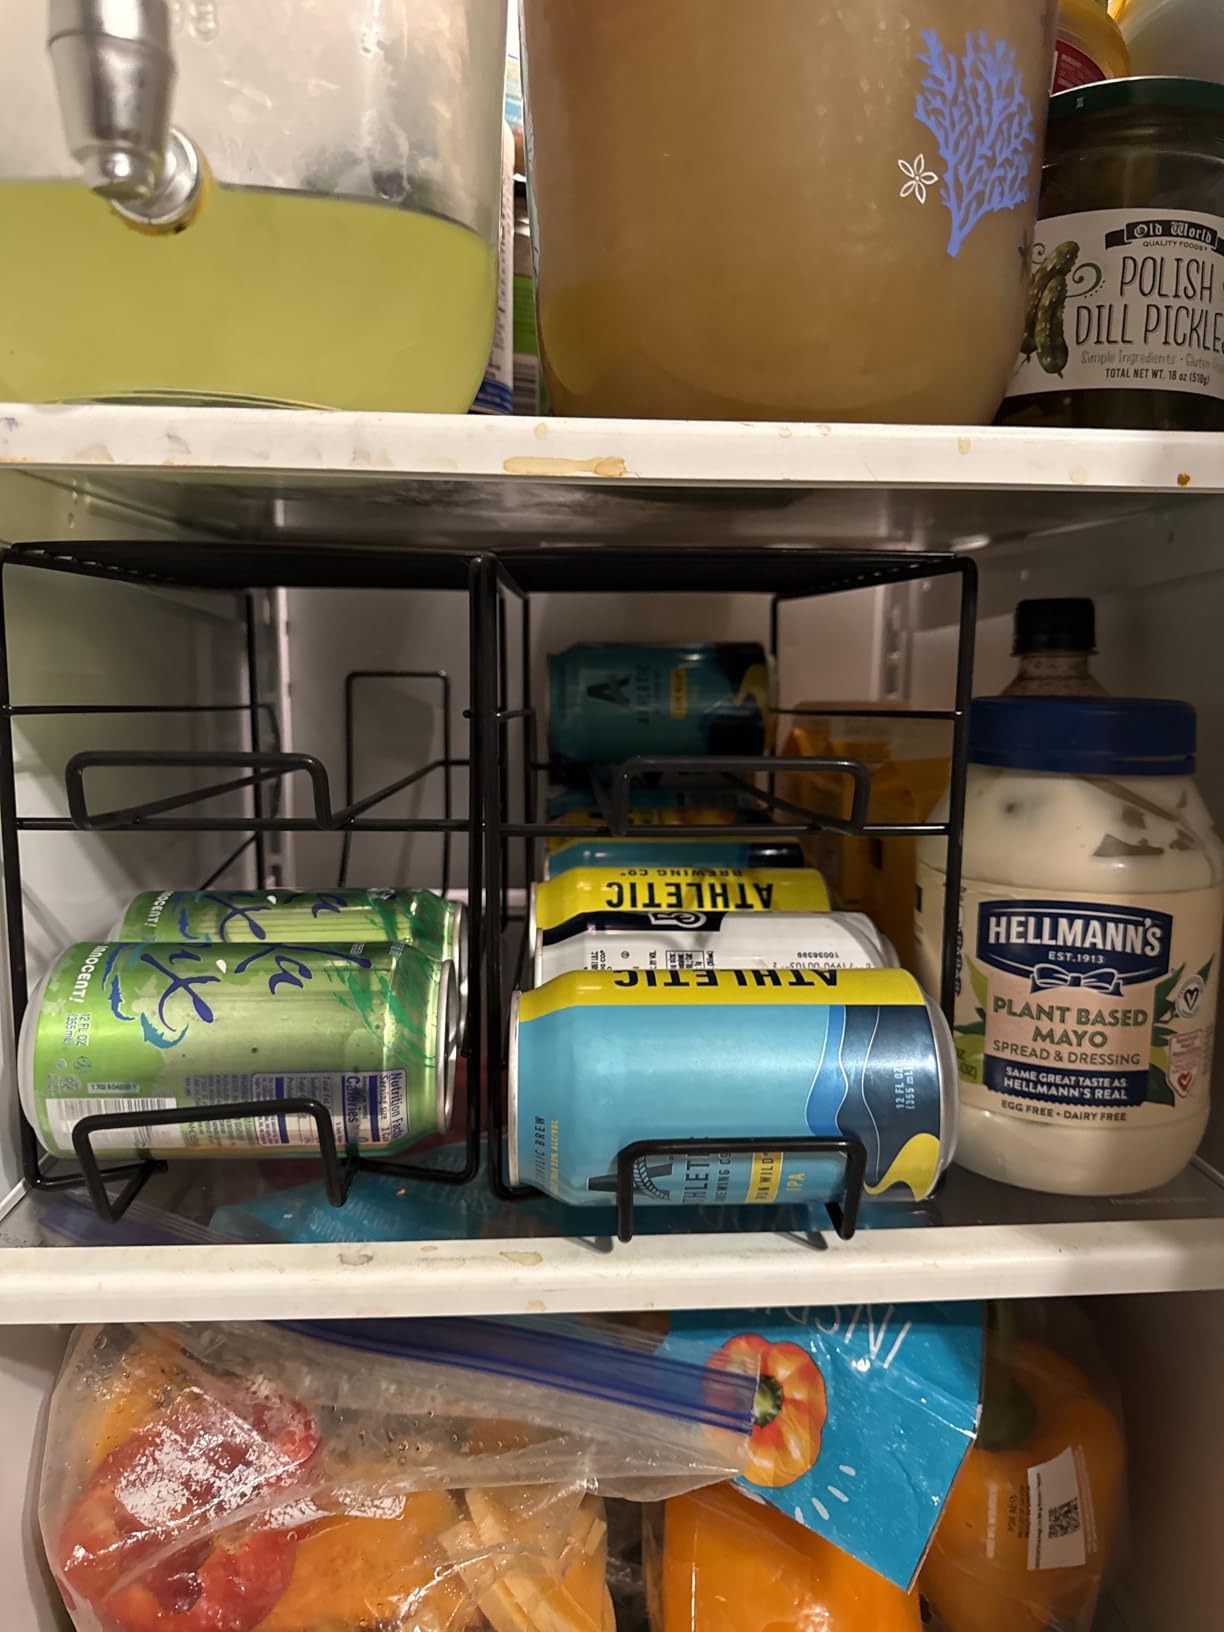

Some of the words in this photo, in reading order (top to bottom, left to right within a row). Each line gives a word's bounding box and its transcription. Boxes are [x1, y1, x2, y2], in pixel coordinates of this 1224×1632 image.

[1133, 223, 1163, 238] Old
[1170, 221, 1213, 244] World
[1142, 240, 1177, 248] QUALITY
[1120, 255, 1215, 304] POLISH
[1075, 303, 1134, 346] DILL
[1143, 303, 1224, 354] PICKLE
[1080, 350, 1114, 365] Simple
[1119, 349, 1177, 366] Ingredients
[1105, 367, 1131, 379] TOTAL
[1132, 368, 1150, 379] NET
[1151, 369, 1165, 380] WT.
[1168, 370, 1177, 380] 18
[1189, 372, 1210, 386] (510g)
[656, 868, 744, 878] BREWING
[604, 880, 775, 910] ATHLETIC
[987, 915, 1164, 958] HELLMANN'S
[1047, 950, 1105, 964] EST.1913
[613, 968, 839, 988] ATHLETIC
[79, 1012, 91, 1022] 12
[992, 996, 1071, 1020] PLANT
[1076, 1006, 1148, 1028] BASED
[77, 1022, 90, 1032] FL
[1031, 1026, 1109, 1048] MAYO
[76, 1034, 89, 1047] OZ
[992, 1039, 1050, 1062] SPREAD
[1053, 1050, 1065, 1063] &
[1067, 1050, 1142, 1066] DRESSING
[893, 1067, 904, 1080] OZ
[1005, 1066, 1037, 1082] SAME
[1038, 1071, 1076, 1085] GREAT
[1077, 1074, 1111, 1087] TASTE
[1112, 1077, 1127, 1087] AS
[378, 1074, 389, 1105] Serving
[390, 1072, 403, 1117] Nutrition
[895, 1082, 905, 1094] FL
[904, 1087, 916, 1110] (355
[1003, 1076, 1091, 1098] HELLMANN'S
[1094, 1088, 1128, 1100] REAL
[346, 1075, 361, 1124] Calories
[895, 1097, 905, 1109] 12
[1001, 1099, 1024, 1113] EGG
[1025, 1104, 1054, 1118] FREE
[1063, 1110, 1098, 1122] DAIRY
[1100, 1112, 1127, 1122] FREE
[380, 1106, 389, 1120] size
[391, 1118, 404, 1140] Facts
[534, 1114, 546, 1148] BREW
[758, 1158, 775, 1184] WILD
[786, 1172, 806, 1192] IPA
